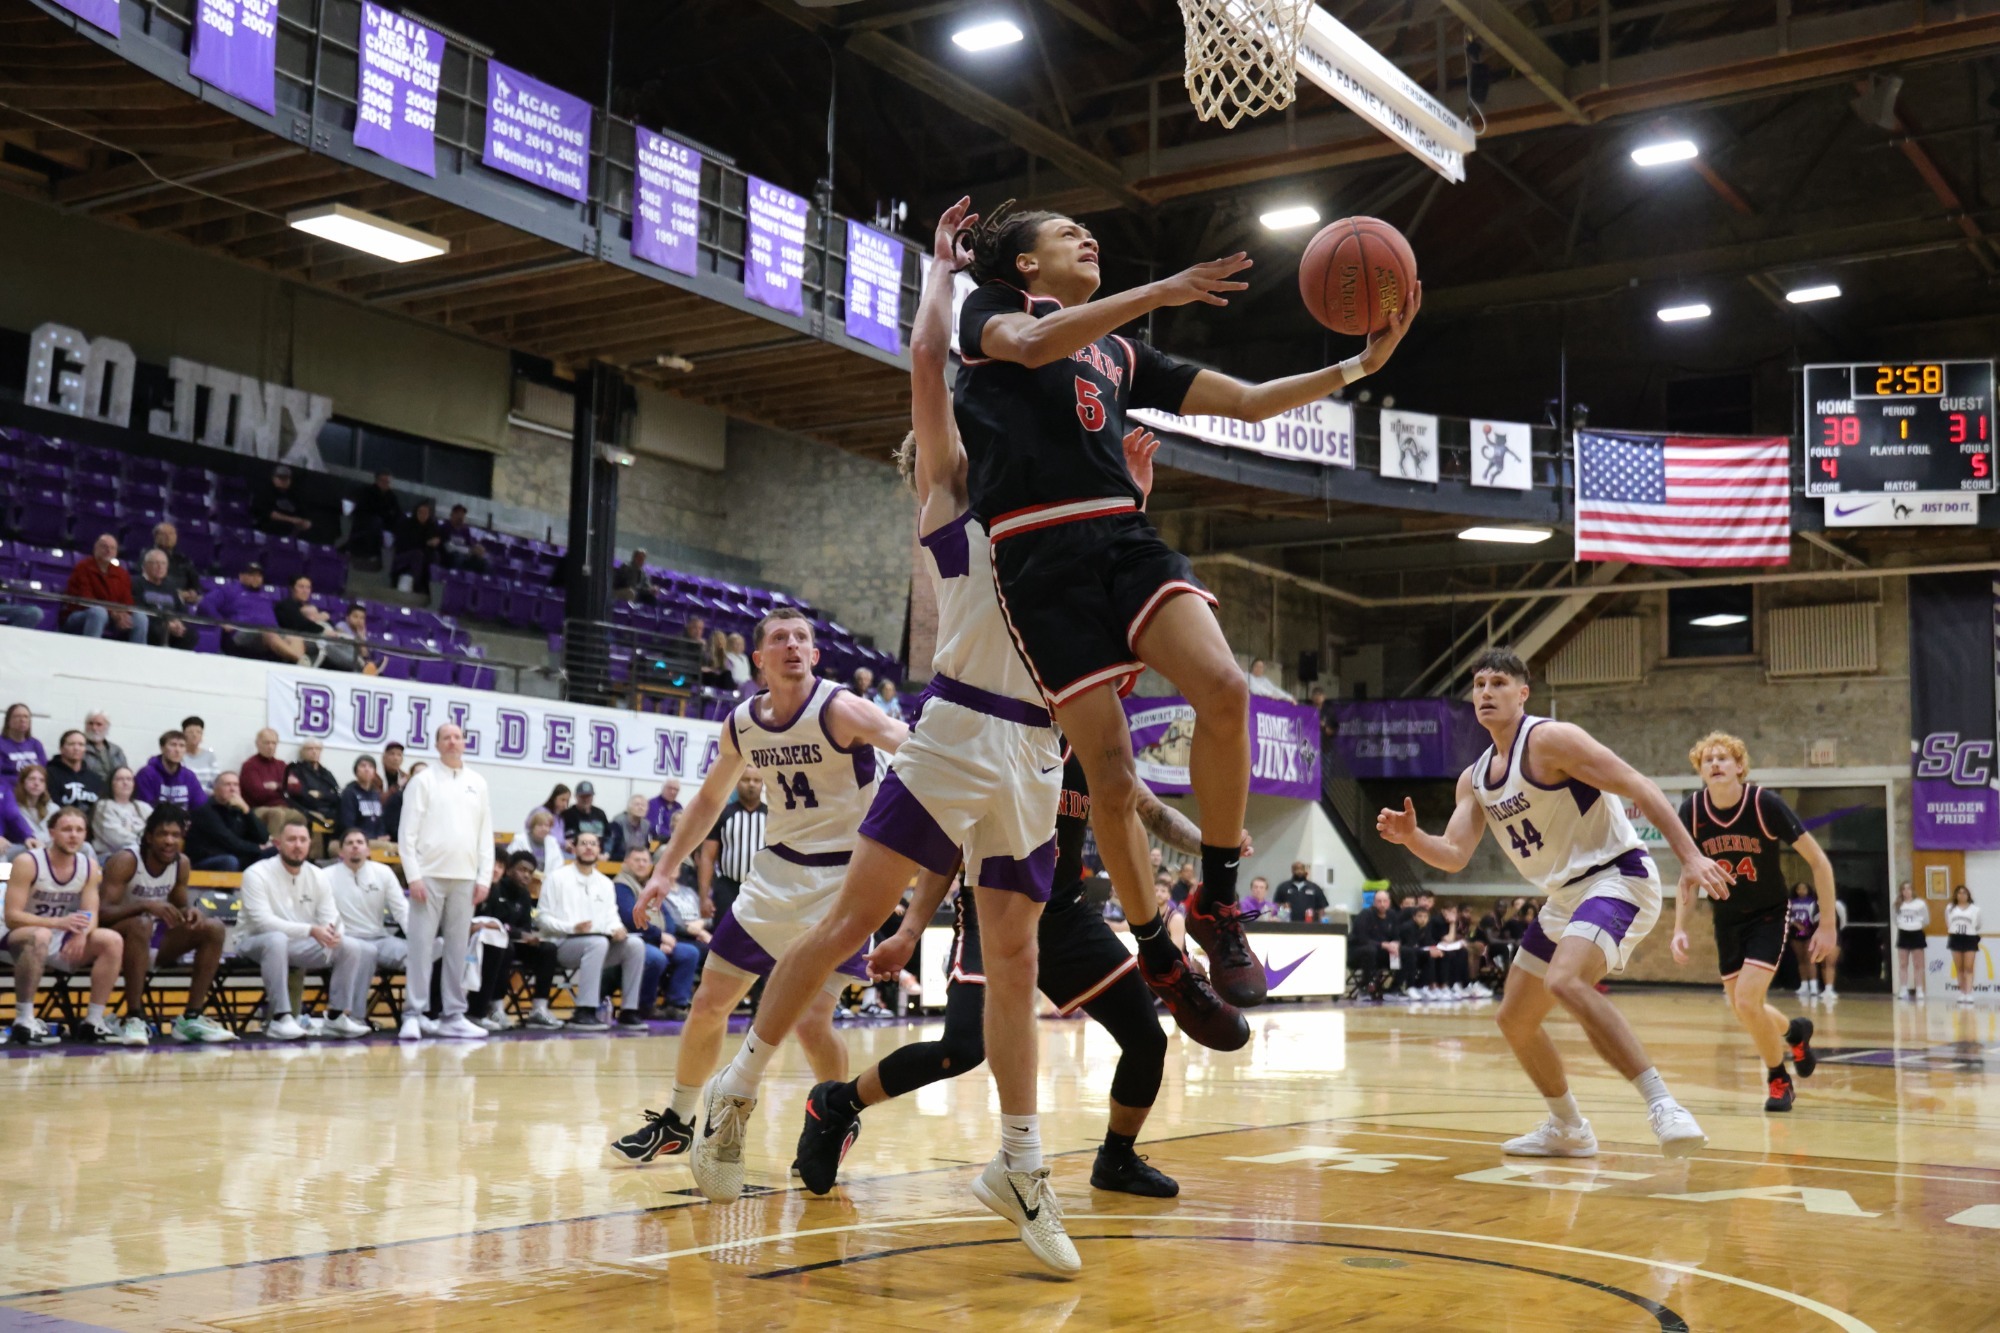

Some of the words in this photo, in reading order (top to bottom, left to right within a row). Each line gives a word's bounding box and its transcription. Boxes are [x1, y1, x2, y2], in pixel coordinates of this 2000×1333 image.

[202, 6, 234, 37] 2008
[241, 10, 274, 38] 2007
[380, 10, 428, 45] NAIA
[365, 33, 440, 78] CHAMPIONS
[413, 41, 429, 59] IV
[362, 69, 394, 96] 2002
[365, 47, 411, 82] WOMEN'S
[412, 71, 438, 93] GOLF
[360, 104, 392, 131] 2012
[518, 90, 560, 120] KCAC
[404, 107, 436, 132] 2007
[492, 97, 583, 147] CHAMPIONS
[1389, 106, 1412, 135] USN
[492, 118, 522, 141] 2018
[525, 132, 554, 155] 2019
[558, 145, 583, 167] 2021
[649, 137, 689, 163] KCAC
[492, 140, 543, 175] Women's
[544, 161, 582, 190] Tennis
[639, 148, 700, 184] CHAMPIONS
[639, 164, 671, 190] WOMEN'S
[759, 184, 796, 210] KCAC
[750, 195, 806, 230] CHAMPIONS
[655, 227, 679, 248] 1991
[861, 232, 890, 256] NAIA
[849, 250, 901, 282] TOURNAMENT
[854, 241, 894, 269] NATIONAL
[1876, 365, 1941, 395] 2:58
[24, 321, 137, 428] GO
[148, 356, 333, 473] JINX
[1075, 375, 1107, 431] 5
[1816, 400, 1856, 415] HOME
[1939, 397, 1984, 411] GUEST
[1882, 406, 1916, 416] PERIOD
[1209, 415, 1266, 443] FIELD
[1276, 421, 1349, 459] HOUSE
[1390, 422, 1415, 435] HOME
[1416, 426, 1427, 435] OF
[1824, 416, 1860, 446] 38
[1901, 419, 1908, 440] 1
[1949, 413, 1987, 443] 31
[1811, 447, 1840, 457] FOULS
[1870, 446, 1905, 456] PLAYER
[1907, 445, 1930, 455] FOUL
[1960, 444, 1989, 454] FOULS
[1821, 458, 1838, 478] 4
[1971, 453, 1988, 478] 5
[1811, 482, 1840, 493] SCORE
[1884, 481, 1917, 491] MATCH
[1961, 480, 1991, 490] SCORE
[1921, 503, 1943, 513] JUST
[1945, 503, 1958, 511] DO
[1960, 503, 1973, 512] IT.
[294, 682, 621, 770] BUILDER
[654, 728, 720, 779] NA
[1134, 709, 1173, 726] Stewart
[1256, 712, 1289, 741] HOME
[751, 744, 823, 769] BUILDERS
[1252, 738, 1297, 782] JINX
[1917, 732, 1993, 785] SC
[777, 771, 819, 810] 14
[1927, 802, 1984, 813] BUILDER
[1936, 814, 1976, 824] PRIDE
[1506, 818, 1544, 858] 44
[1702, 835, 1761, 856] FRIENDS
[1973, 984, 1991, 992] vin'
